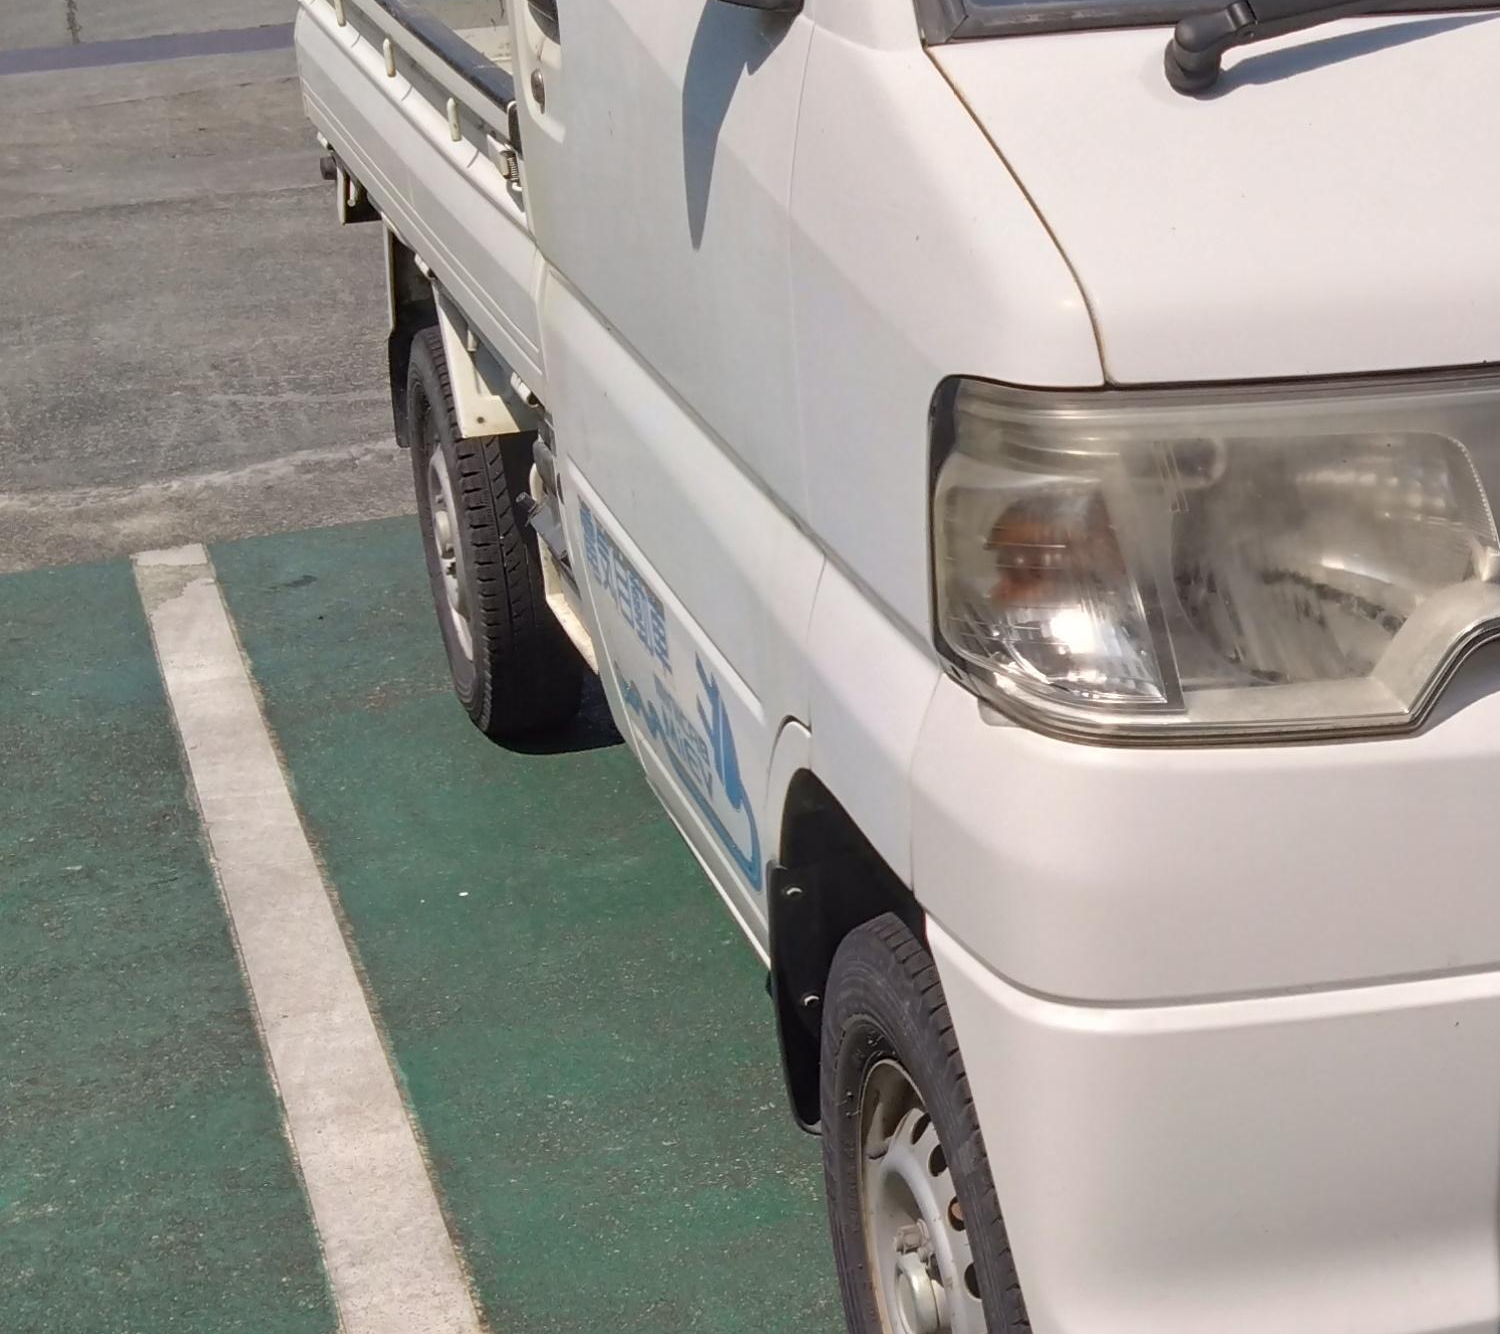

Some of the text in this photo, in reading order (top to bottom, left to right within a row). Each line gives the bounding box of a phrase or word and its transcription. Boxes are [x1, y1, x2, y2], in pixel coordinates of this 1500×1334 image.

[578, 502, 673, 677] 電気自動車
